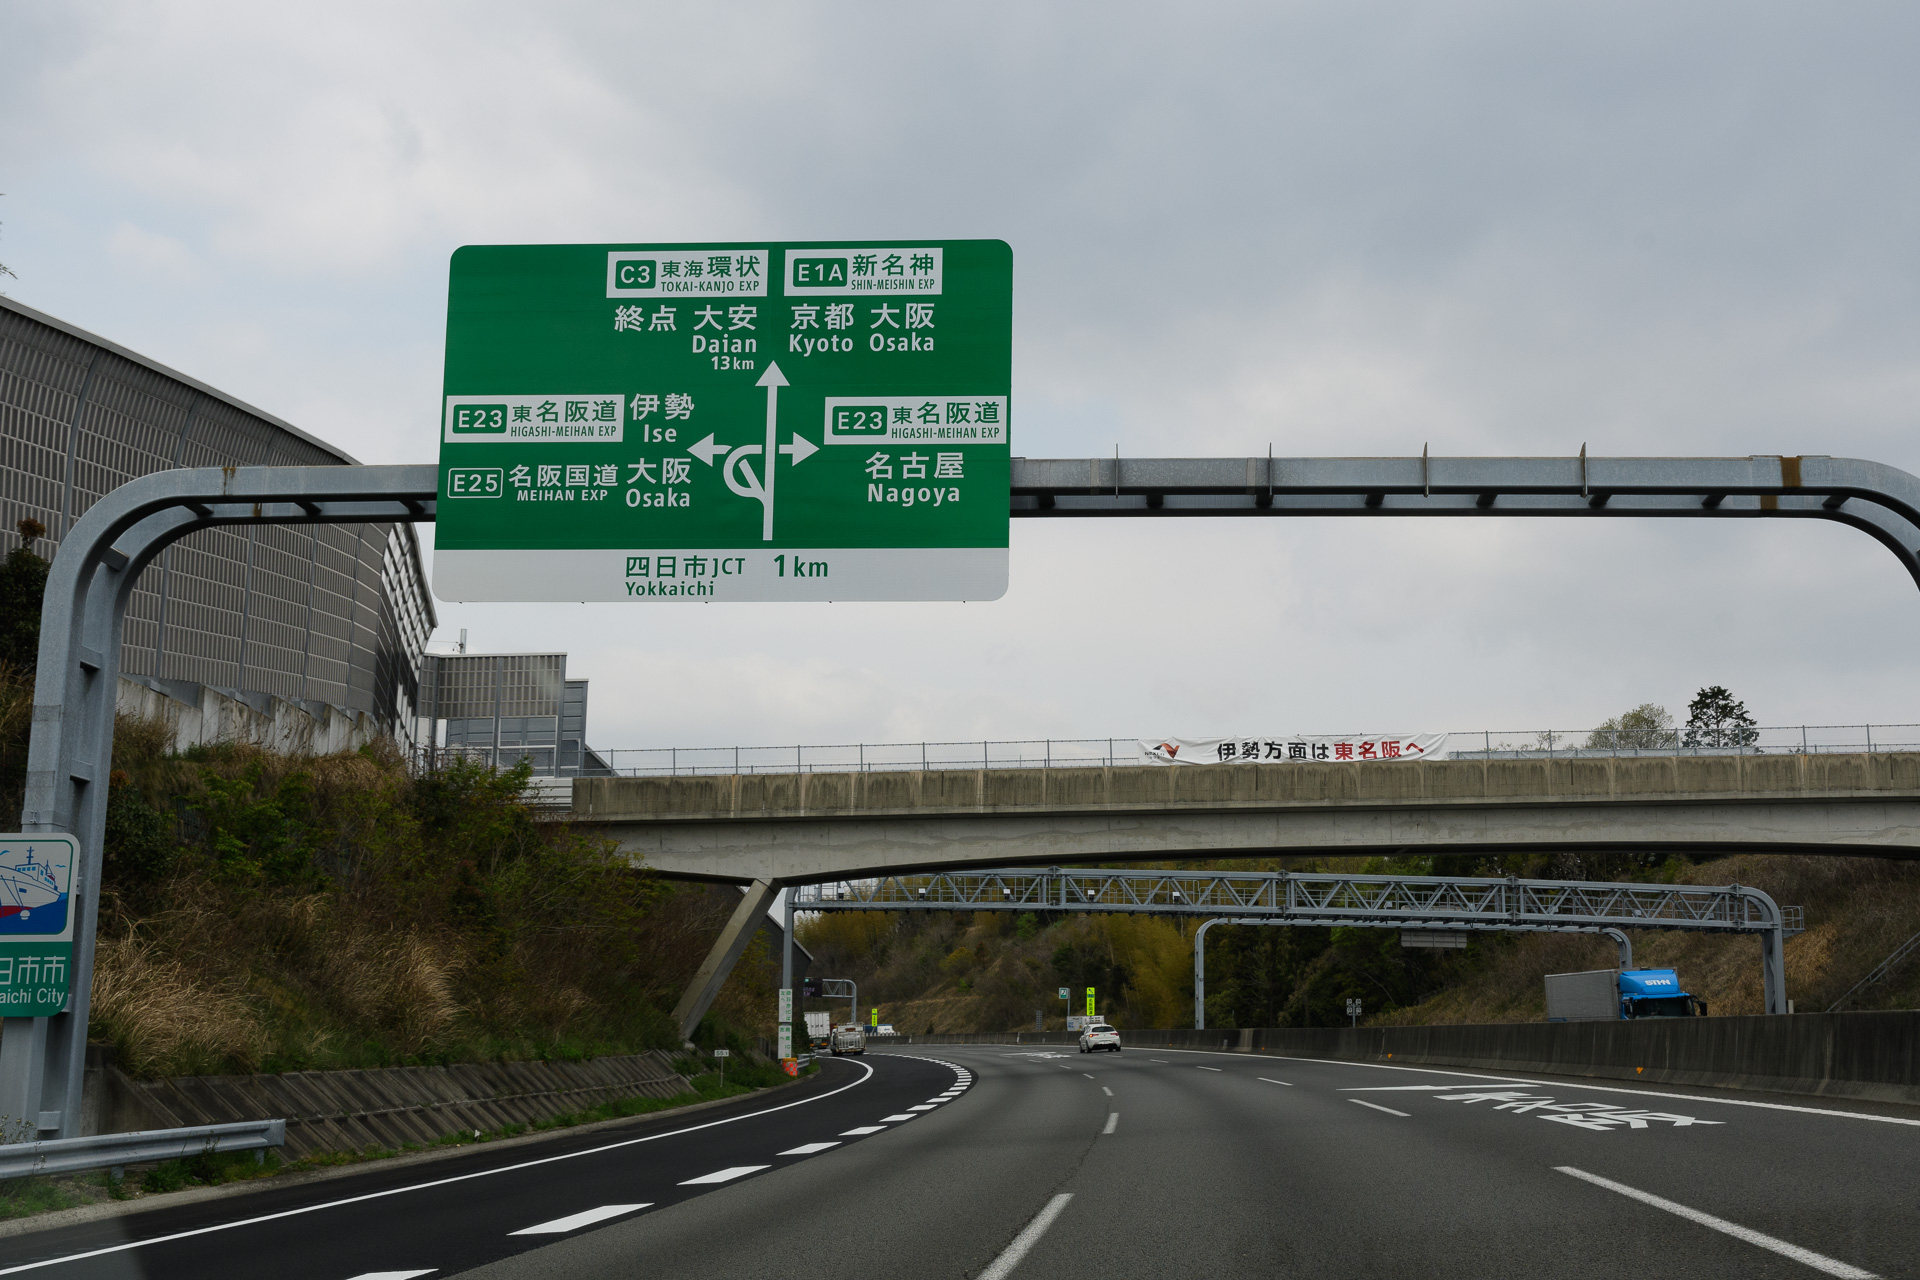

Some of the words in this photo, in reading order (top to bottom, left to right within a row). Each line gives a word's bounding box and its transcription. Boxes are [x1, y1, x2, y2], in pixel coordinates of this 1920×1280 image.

[621, 266, 650, 283] C3
[661, 256, 760, 278] 東海環状
[799, 264, 842, 281] E1A
[853, 254, 933, 276] 新名神
[661, 281, 734, 293] TOKAI-KANJO
[740, 281, 759, 291] EXP
[852, 279, 914, 290] SHIN-MEISHIN
[918, 279, 934, 289] EXP
[614, 305, 676, 332] 終点
[694, 304, 757, 330] 大安
[791, 303, 854, 329] 京都
[870, 303, 934, 329] 大阪
[693, 334, 756, 353] Daian
[790, 334, 853, 356] Kyoto
[870, 332, 933, 351] Osaka
[512, 400, 616, 423] 東名阪道
[630, 393, 694, 420] 伊勢
[893, 402, 999, 424] 東名阪道
[459, 410, 502, 427] E23
[838, 412, 882, 429] E23
[511, 426, 594, 437] HIGASHI-MEIHAN
[599, 426, 616, 436] EXP
[644, 424, 676, 442] Ise
[892, 428, 978, 438] HIGASHI-MEIHAN
[982, 428, 999, 438] EXP
[627, 458, 691, 484] 大阪
[865, 452, 964, 479] 名古屋
[454, 474, 497, 492] E25
[509, 464, 618, 487] 名阪国道
[517, 490, 574, 501] MEIHAN
[582, 490, 607, 500] EXP
[626, 488, 689, 507] Osaka
[868, 484, 959, 507] Nagoya
[626, 581, 713, 595] Yokkaichi
[1217, 741, 1425, 761] 伊勢方面は東名阪へ
[37, 988, 64, 1006] City
